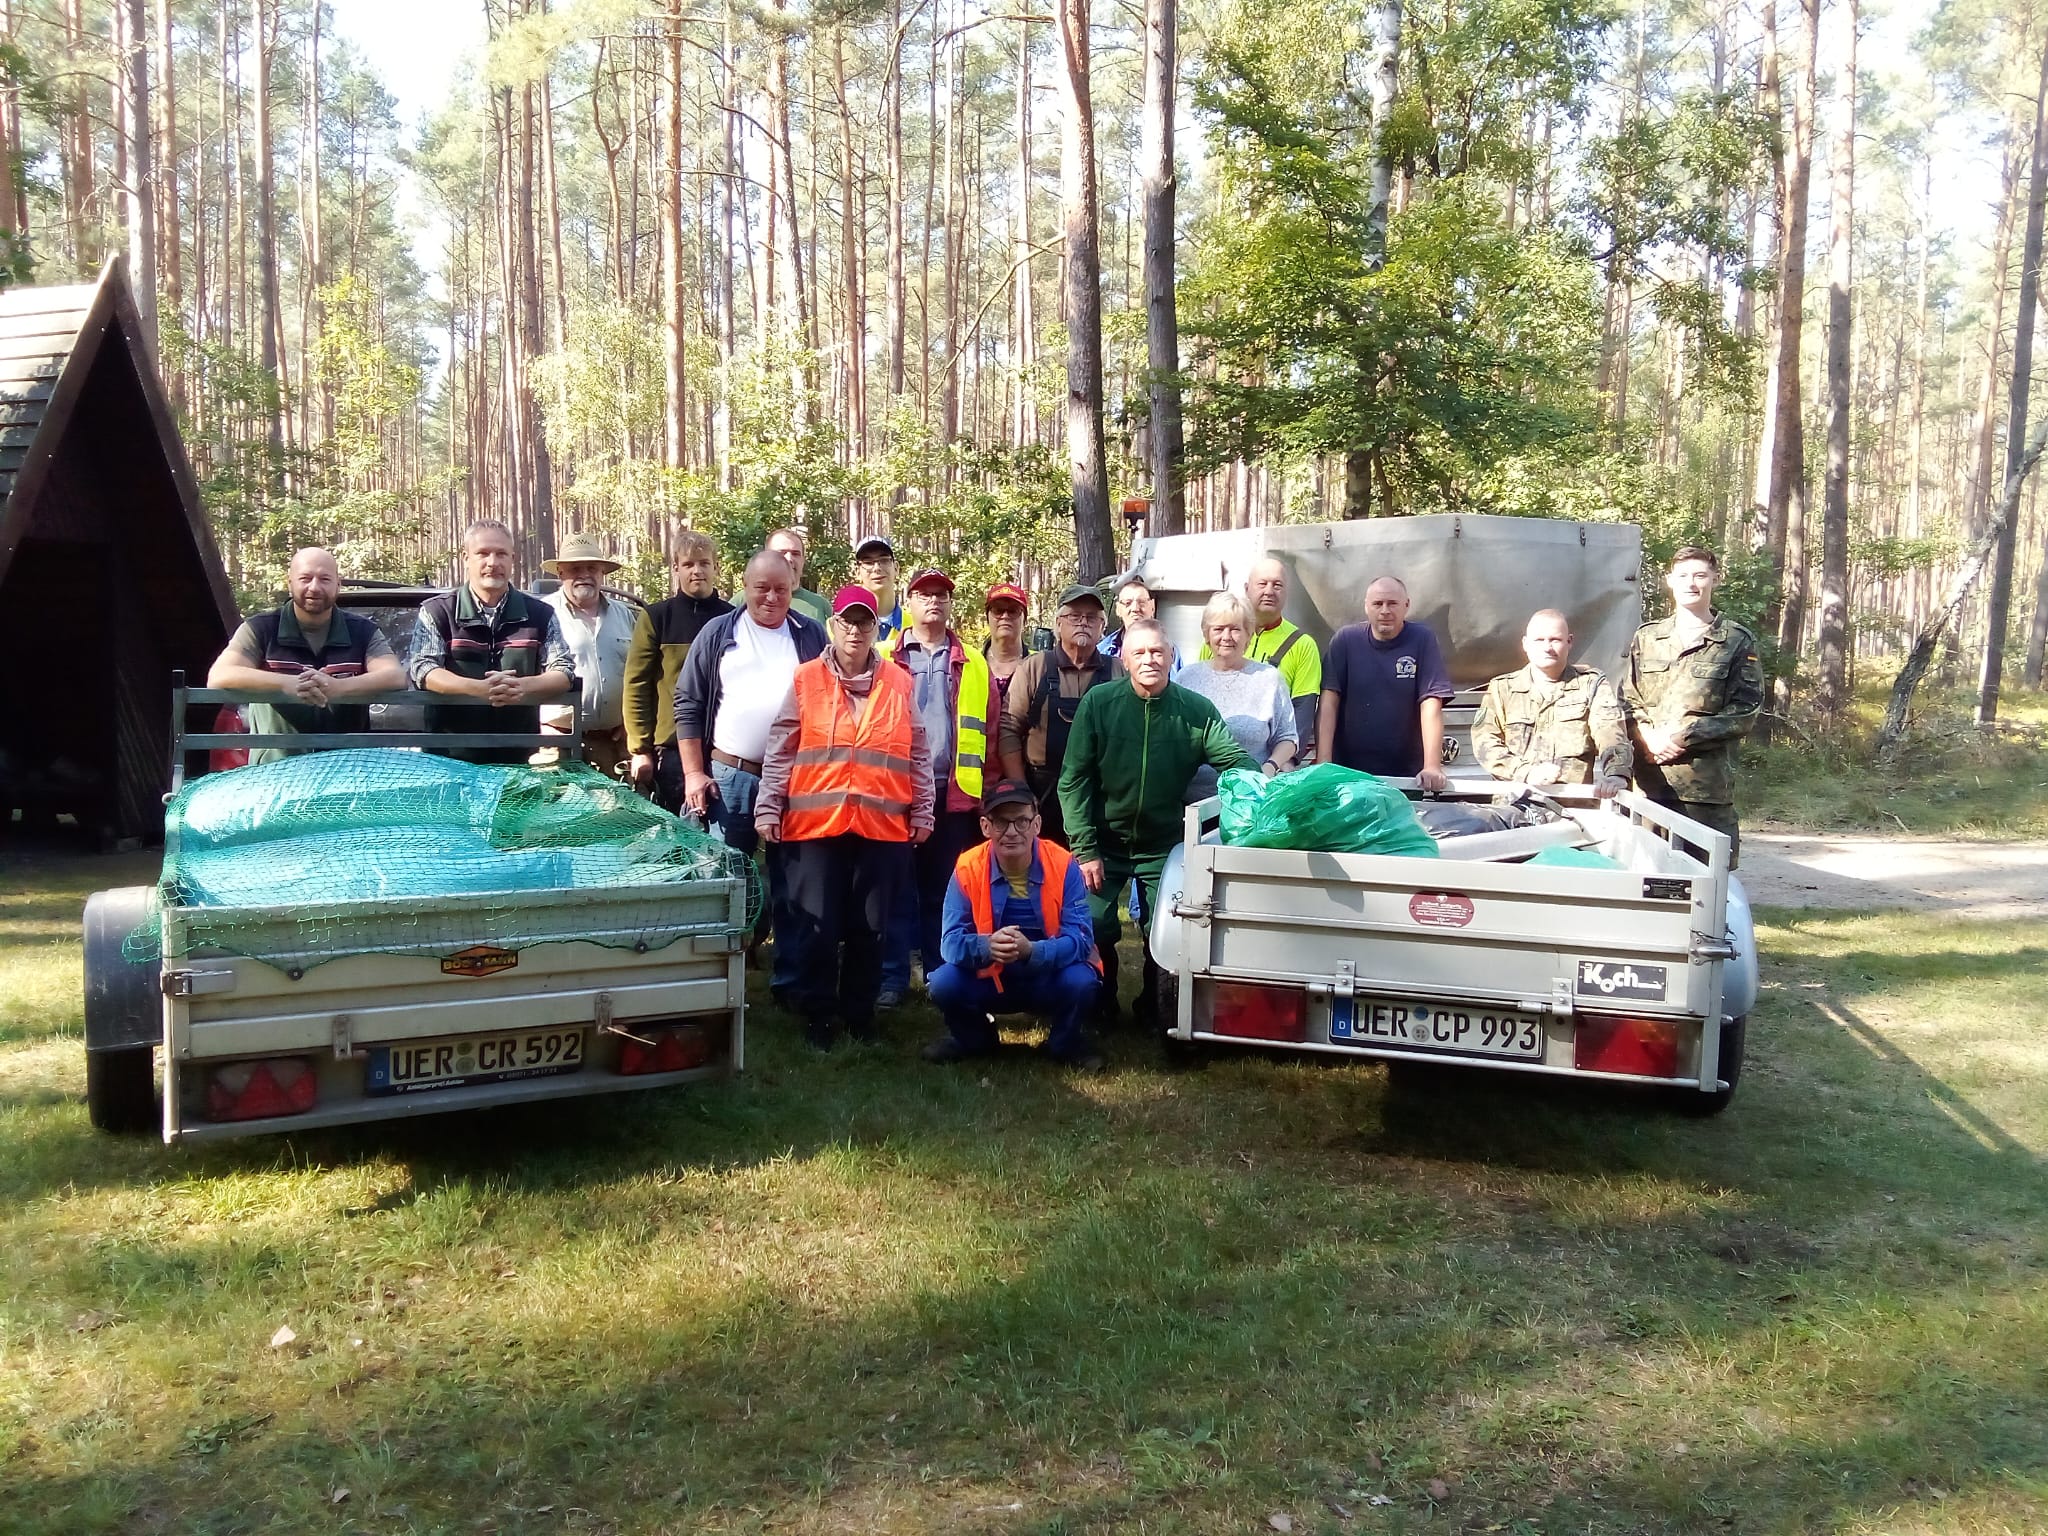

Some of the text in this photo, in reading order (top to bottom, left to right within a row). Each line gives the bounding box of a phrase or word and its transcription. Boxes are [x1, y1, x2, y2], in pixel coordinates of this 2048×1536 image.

[1583, 962, 1640, 993] Koch
[1338, 1003, 1537, 1050] D UER CP 993
[375, 1032, 580, 1080] D UER CR 592
